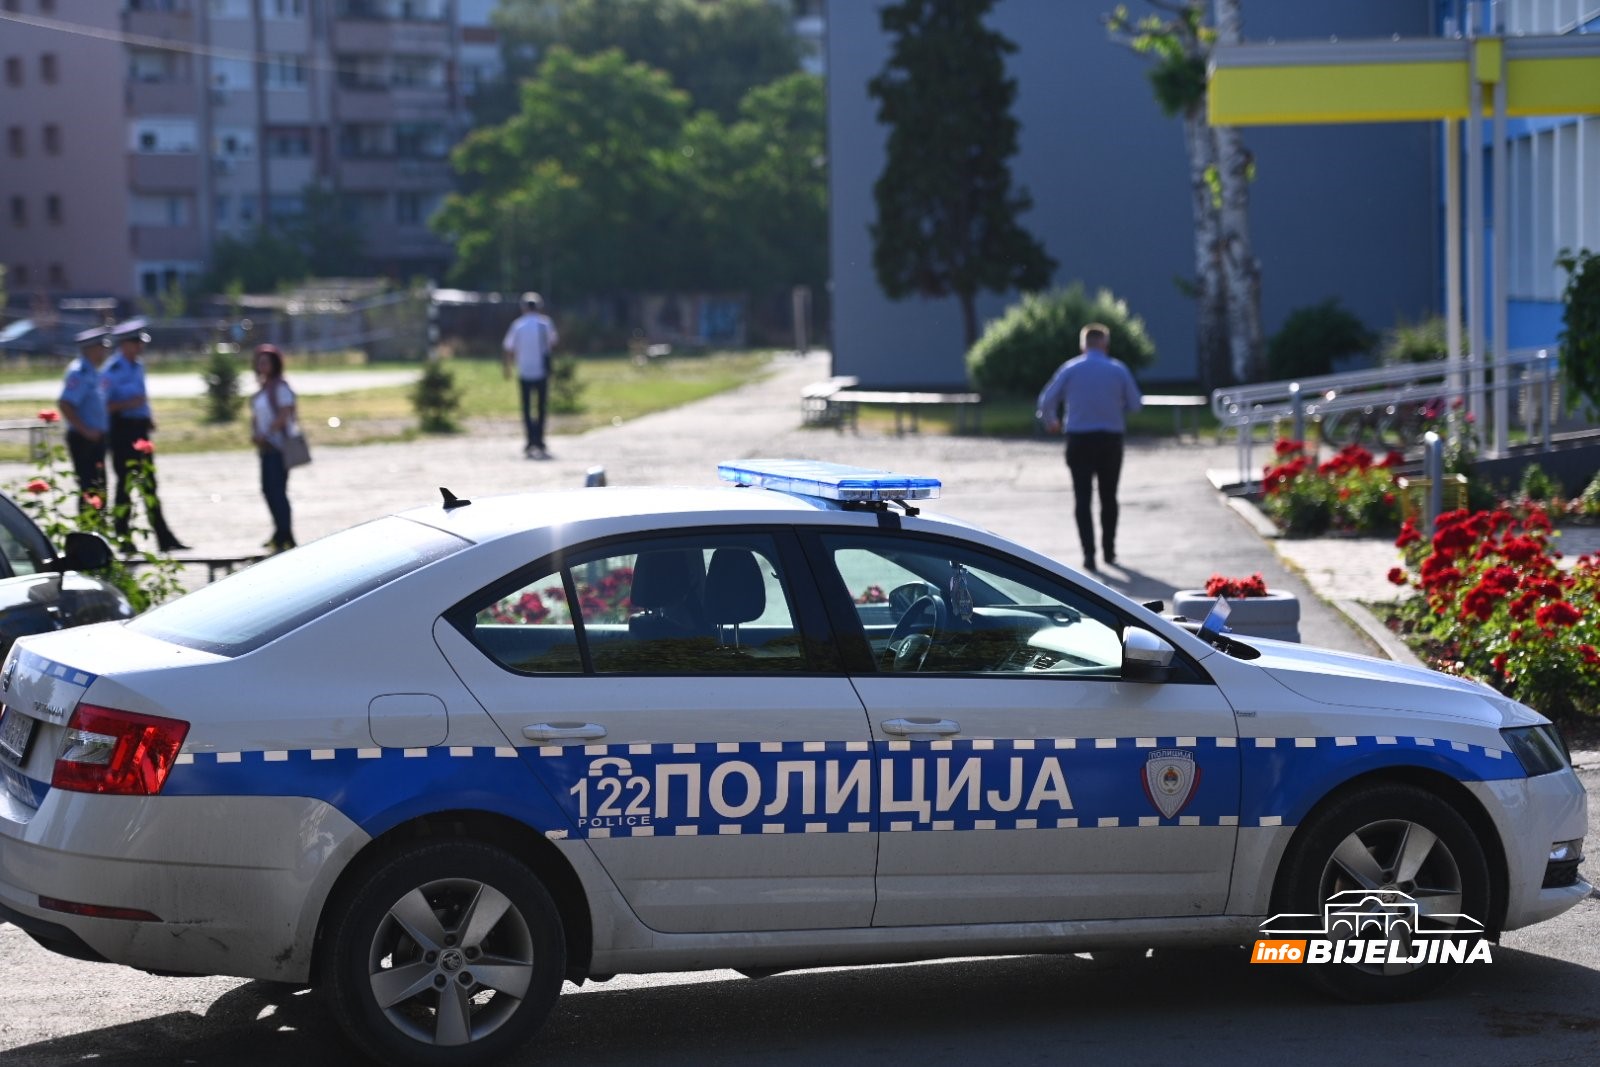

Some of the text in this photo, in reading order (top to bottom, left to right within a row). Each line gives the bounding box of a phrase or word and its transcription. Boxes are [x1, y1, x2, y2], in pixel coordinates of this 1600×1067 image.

[570, 776, 650, 818] 122
[655, 757, 1074, 823] ПОЛИЦИЈА
[578, 815, 651, 828] POLICE
